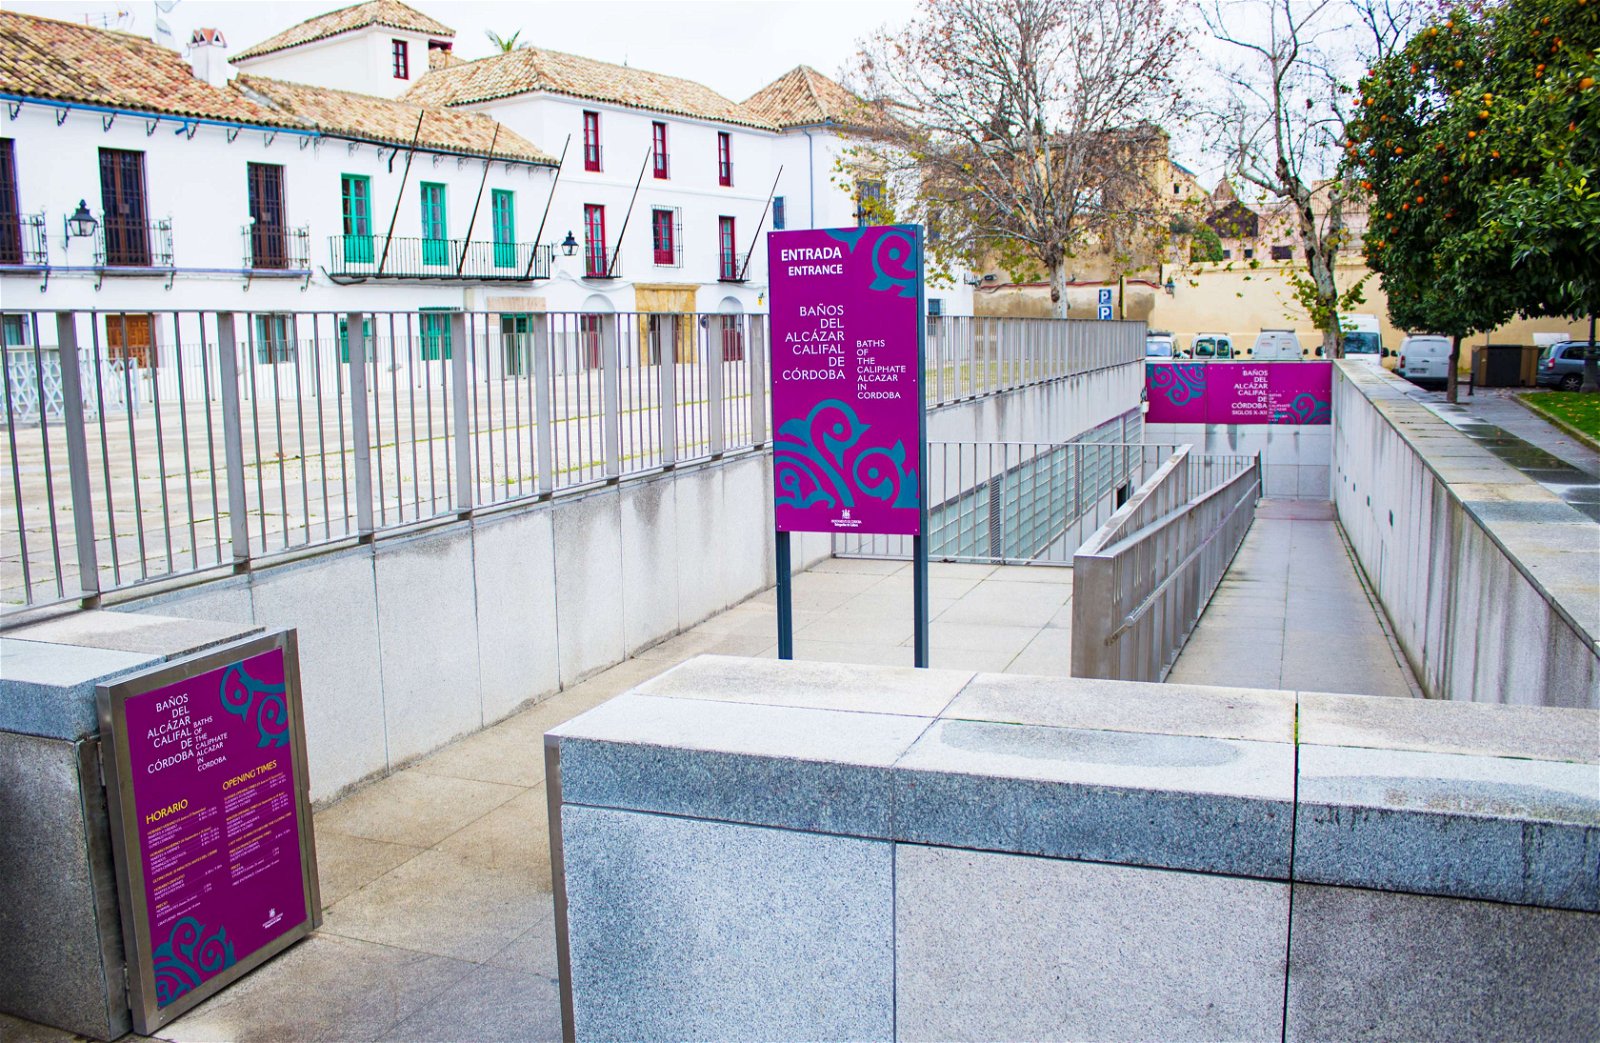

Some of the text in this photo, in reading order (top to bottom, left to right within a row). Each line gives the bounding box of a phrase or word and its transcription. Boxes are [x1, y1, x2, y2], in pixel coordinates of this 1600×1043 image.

[781, 247, 842, 261] ENTRADA
[788, 264, 843, 276] ENTRANCE
[1100, 290, 1109, 304] P
[800, 304, 844, 316] BAÑOS
[1101, 307, 1110, 319] P
[820, 318, 844, 328] DEL
[785, 329, 844, 342] ALCÁZAR
[793, 344, 845, 354] CALIFAL
[829, 357, 844, 366] DE
[783, 369, 845, 380] CÓRDOBA
[156, 693, 189, 712] BAÑOS
[172, 706, 190, 718] DEL
[147, 716, 191, 739] ALCÁZAR
[193, 716, 213, 728] BATHS
[154, 729, 192, 748] CALIFAL
[195, 733, 208, 742] THE
[195, 732, 228, 750] CALIPHATE
[181, 740, 193, 750] DE
[197, 742, 224, 757] ALCAZAR
[147, 750, 194, 774] CÓRDOBA
[198, 756, 227, 772] CORDOBA
[222, 760, 278, 791] OPENING TIMES
[146, 798, 188, 824] HORARIO
